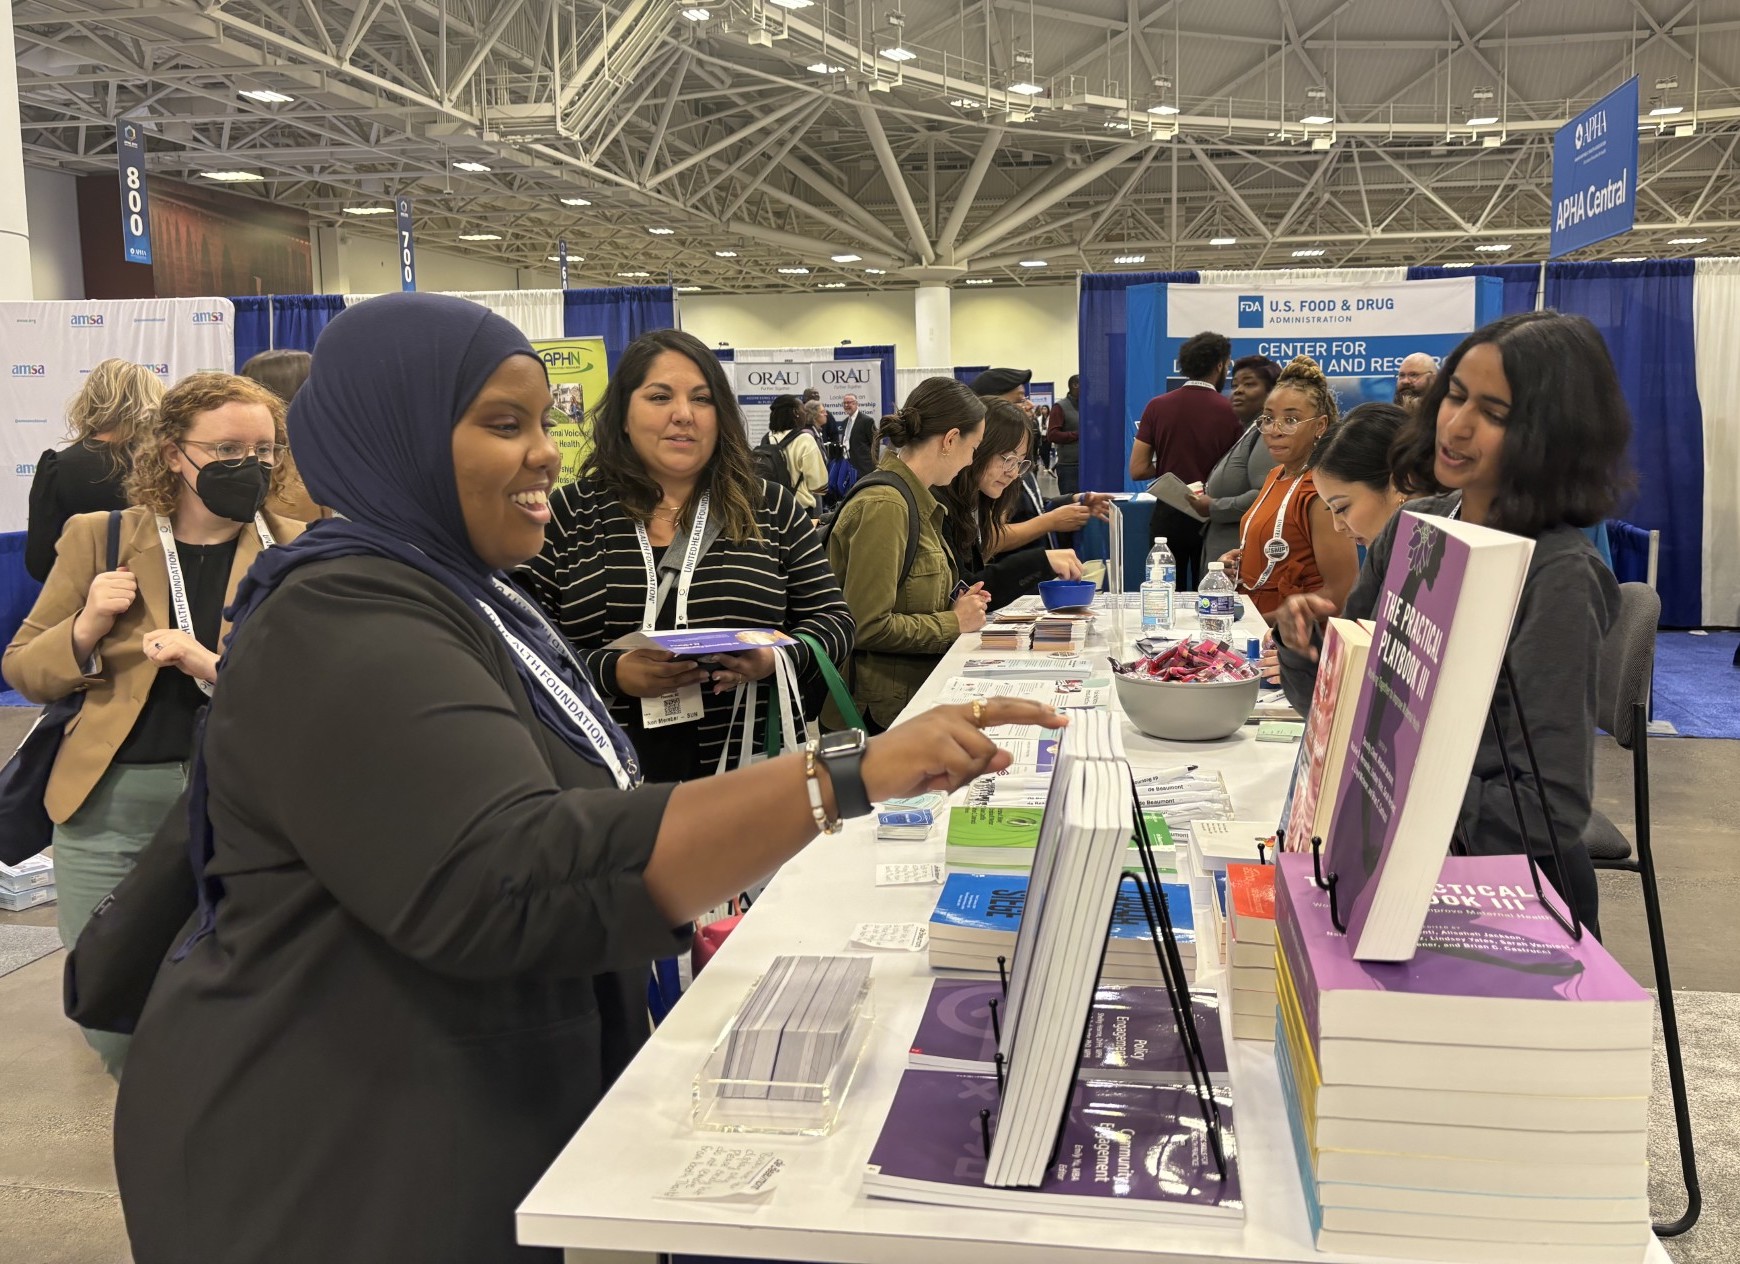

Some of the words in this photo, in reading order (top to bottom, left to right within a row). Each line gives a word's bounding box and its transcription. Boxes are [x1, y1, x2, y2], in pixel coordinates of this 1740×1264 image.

[1583, 110, 1607, 146] APHA
[127, 166, 143, 236] 800
[1556, 191, 1585, 233] APHA
[1587, 168, 1627, 218] Central
[402, 231, 413, 283] 700
[1240, 301, 1262, 312] FDA
[1270, 300, 1295, 313] U.S.
[1300, 299, 1336, 312] FOOD
[1342, 299, 1351, 311] &
[1356, 298, 1394, 311] DRUG
[71, 314, 104, 325] amsa
[192, 311, 224, 323] amsa
[1269, 315, 1353, 324] ADMINISTRATION
[1258, 342, 1327, 357] CENTER
[1332, 341, 1367, 356] FOR
[543, 351, 581, 366] APHN
[1327, 358, 1366, 373] AND
[12, 364, 45, 375] amsa
[748, 370, 800, 385] ORAU
[822, 367, 871, 384] ORAU
[559, 440, 581, 448] Health
[15, 463, 37, 474] am
[689, 519, 704, 546] HEALTH
[684, 545, 698, 573] UNITED
[167, 551, 184, 605] FOUNDATION
[178, 605, 190, 635] HEALTH
[1383, 590, 1404, 627] THE
[1401, 603, 1444, 664] PRACTICAL
[1377, 629, 1422, 691] PLAYBOOK
[1416, 665, 1431, 701] III
[540, 669, 609, 748] FOUNDATION
[1156, 784, 1184, 792] Beaumont
[1146, 798, 1175, 806] Beaumont
[1434, 883, 1535, 898] CTICAL
[986, 889, 1026, 918] SIEGE
[1491, 898, 1526, 911] III
[1113, 1016, 1130, 1060] Engagement
[1131, 1039, 1148, 1061] Policy
[1057, 1164, 1068, 1181] Editor
